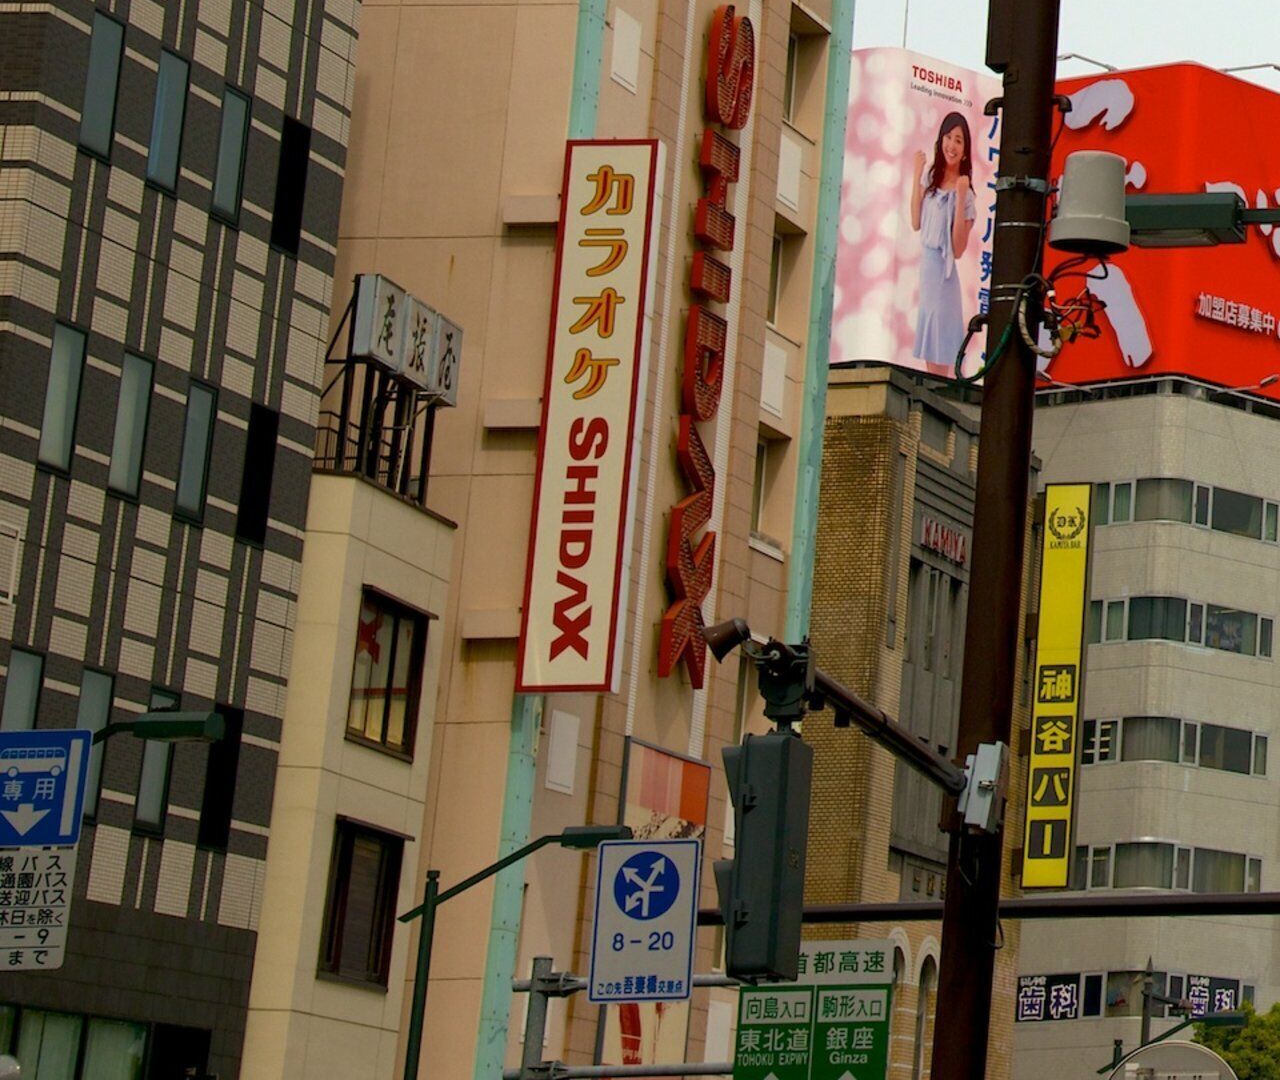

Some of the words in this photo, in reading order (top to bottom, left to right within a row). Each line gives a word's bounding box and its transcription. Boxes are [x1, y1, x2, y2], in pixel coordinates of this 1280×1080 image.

[910, 82, 933, 97] Leading
[912, 65, 963, 93] TOSHIBA
[564, 164, 635, 400] カラオケ
[1198, 292, 1275, 336] 加盟店募集中
[658, 3, 756, 690] SHIDAX
[548, 416, 609, 662] SHIDAX
[920, 514, 967, 565] KAMIYA
[1033, 669, 1072, 855] 神谷バー
[2, 778, 56, 801] 専用
[8, 951, 49, 966] まで
[745, 996, 806, 1020] 向島入口
[822, 994, 882, 1019] 駒形入口
[1018, 984, 1077, 1020] 歯科
[1189, 986, 1235, 1019] 歯科
[739, 1028, 809, 1052] 東北道
[826, 1027, 874, 1050] 銀座
[737, 1052, 774, 1067] TOHOKU
[779, 1052, 809, 1066] EXPWY
[829, 1051, 868, 1064] Ginza
